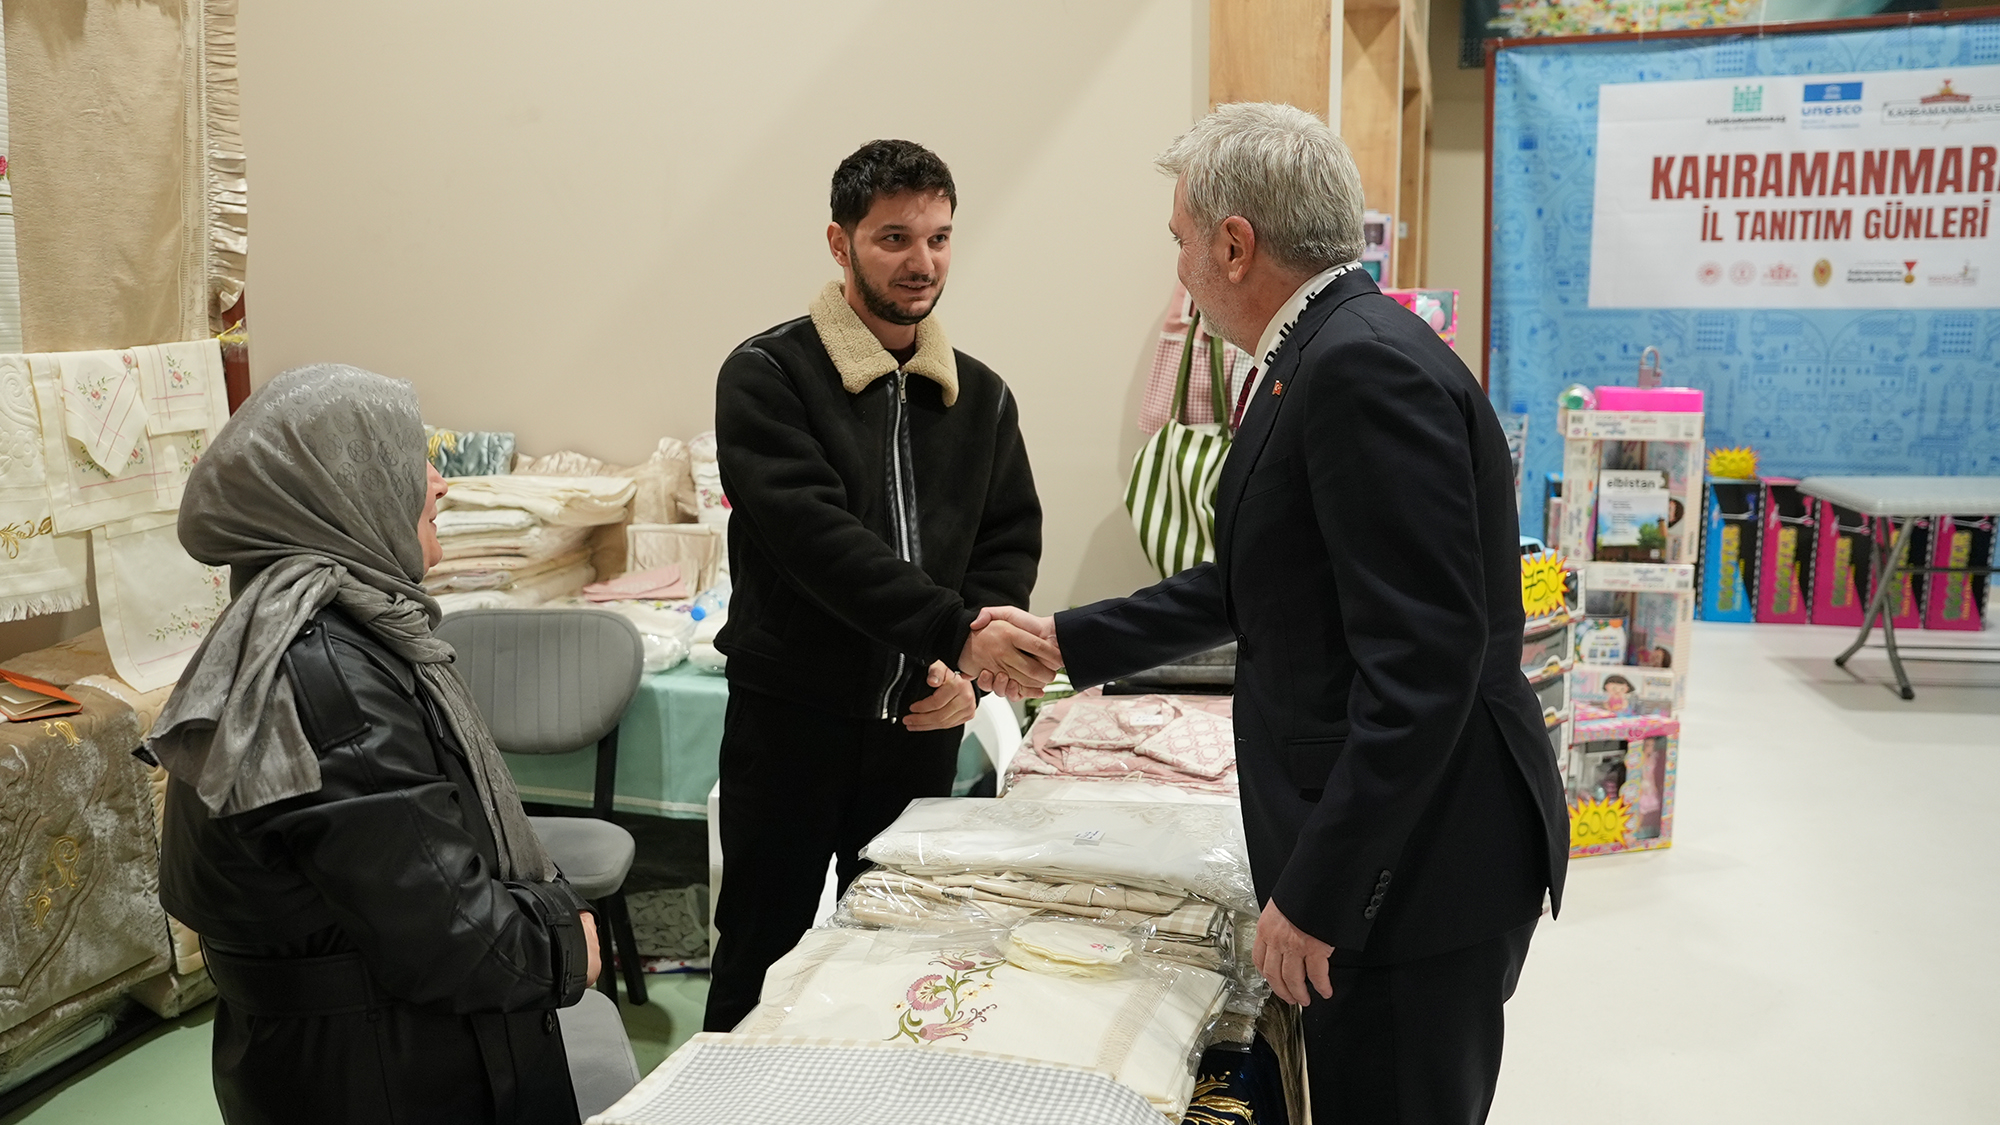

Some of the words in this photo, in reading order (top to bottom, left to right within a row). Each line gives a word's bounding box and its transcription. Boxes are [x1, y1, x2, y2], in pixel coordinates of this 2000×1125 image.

[1801, 103, 1863, 116] unesco
[1651, 146, 2000, 200] KAHRAMANMAR
[1700, 205, 1723, 241] İL
[1735, 209, 1853, 241] TANITIM
[1864, 199, 1992, 240] GÜNLERİ
[1606, 476, 1656, 489] elbistan
[1522, 566, 1559, 602] 750
[1576, 808, 1617, 837] 600
